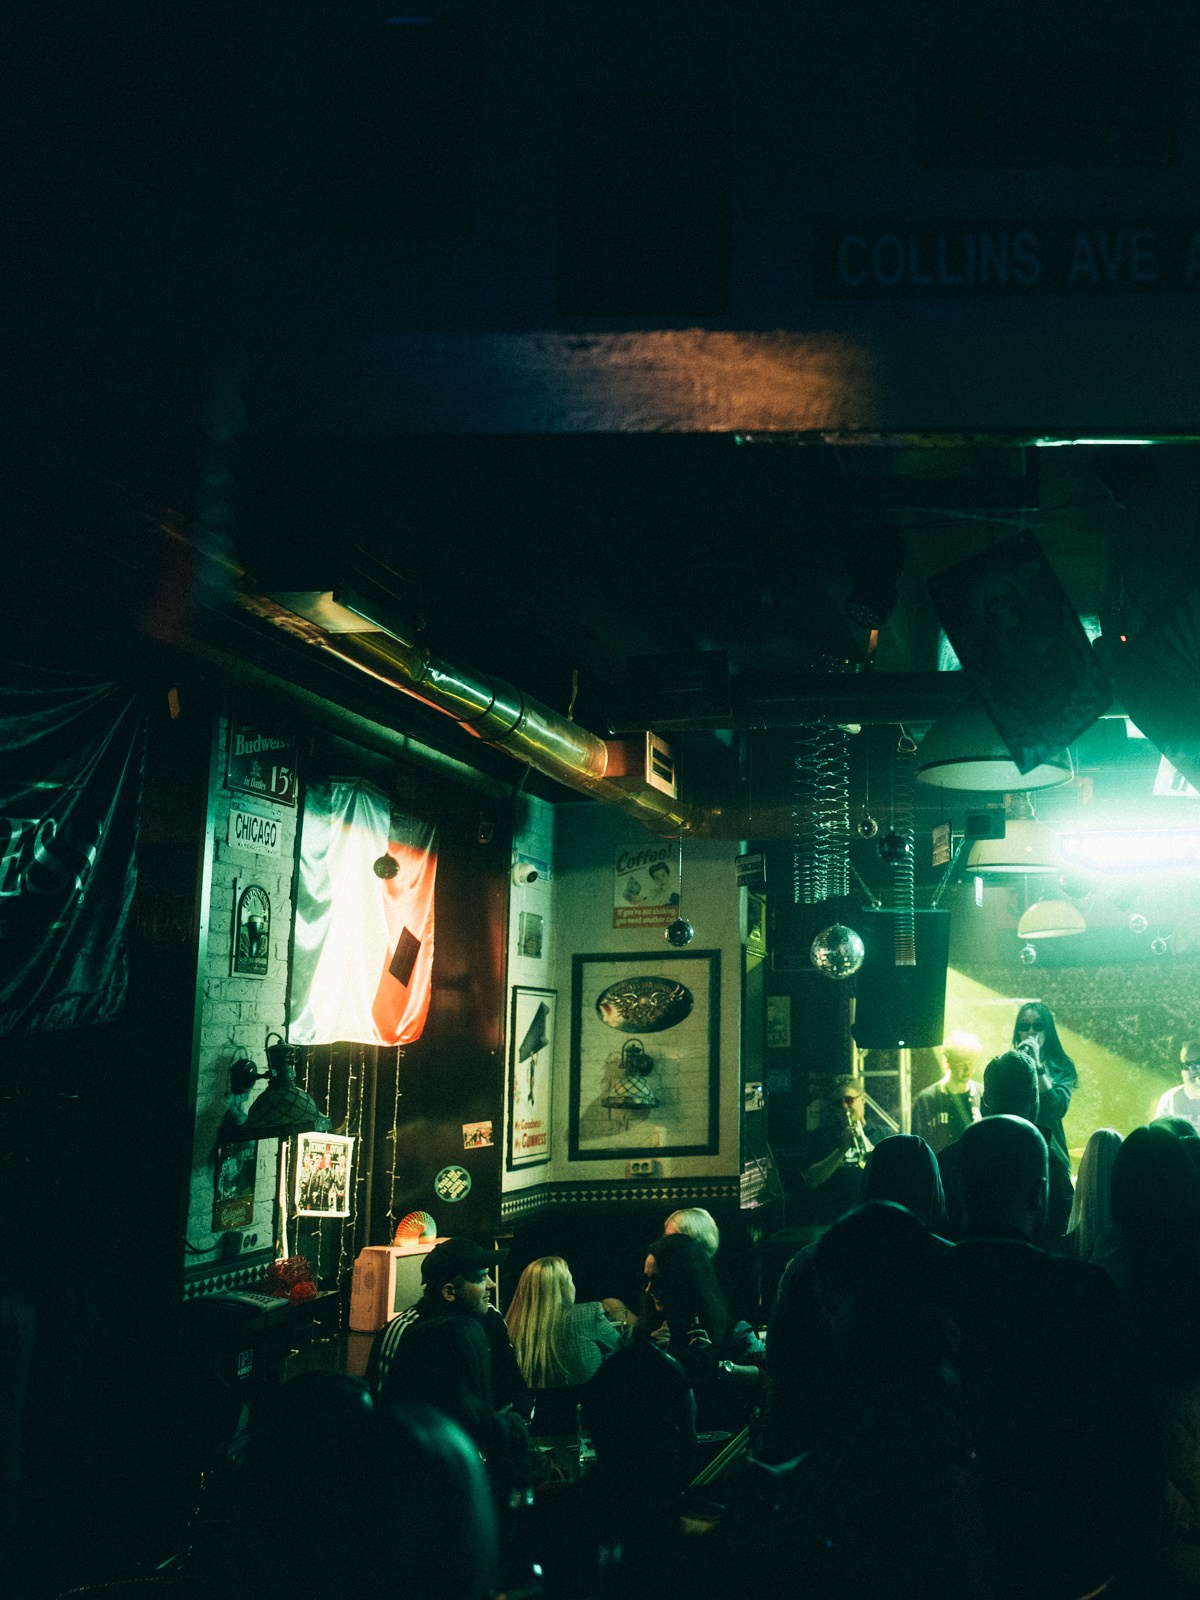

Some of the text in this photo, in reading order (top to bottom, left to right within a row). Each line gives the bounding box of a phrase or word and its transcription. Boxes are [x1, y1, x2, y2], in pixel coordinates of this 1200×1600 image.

[836, 230, 1043, 287] COLLINS
[1067, 229, 1157, 285] AVE
[235, 813, 277, 847] CHICAGO
